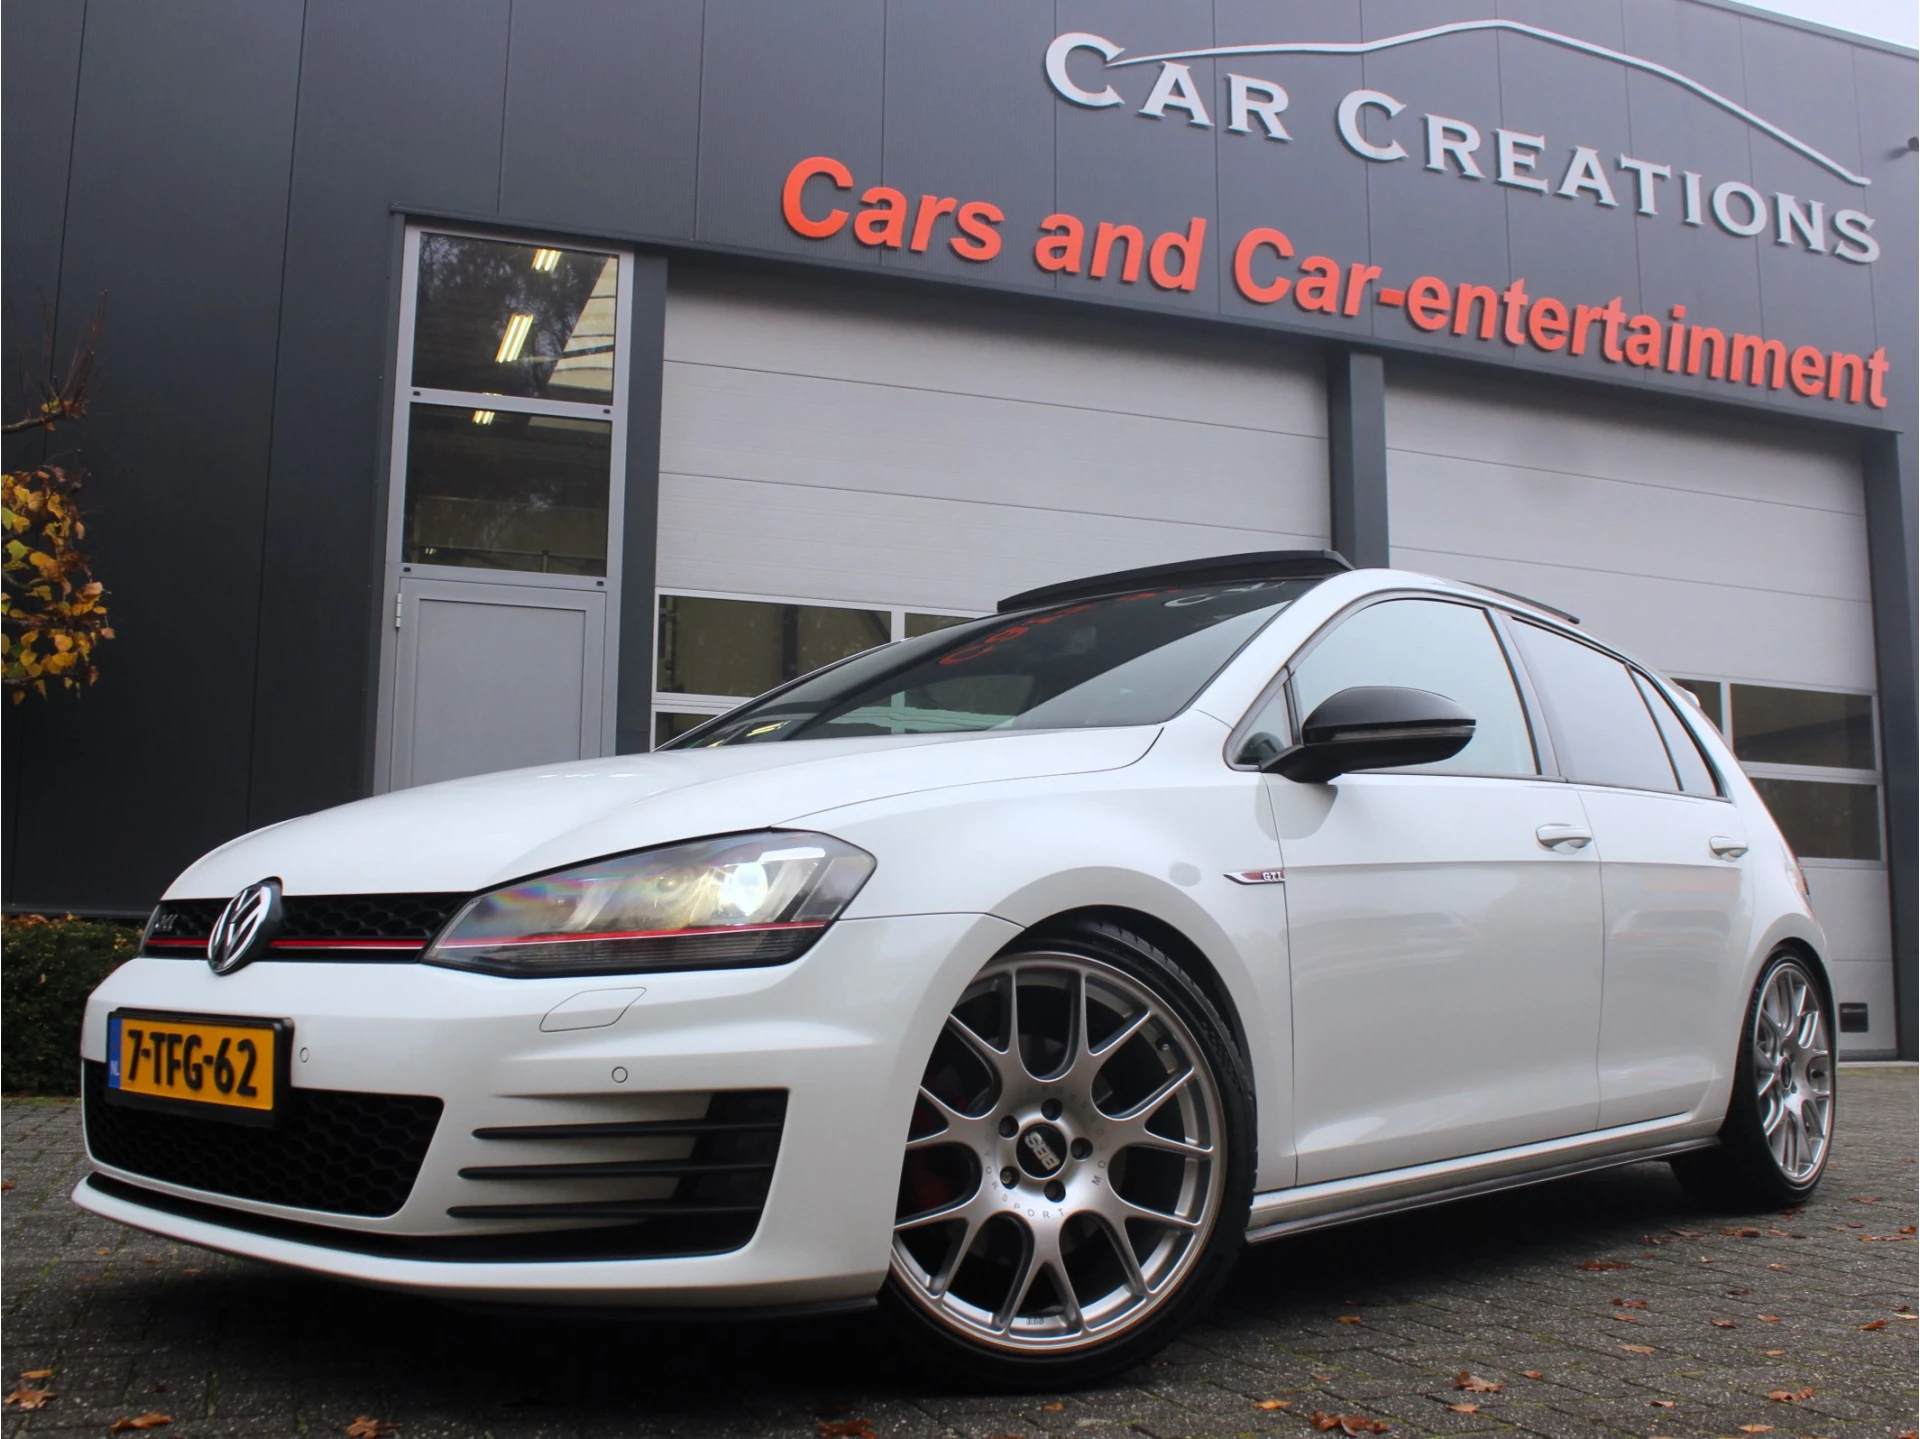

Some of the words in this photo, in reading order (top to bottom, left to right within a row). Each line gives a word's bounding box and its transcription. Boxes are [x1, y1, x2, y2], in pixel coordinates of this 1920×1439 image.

[1045, 31, 1293, 142] CAR
[1337, 89, 1881, 265] CREATIONS
[782, 156, 1005, 261] Cars
[1034, 213, 1207, 292] and
[1233, 226, 1889, 408] Car-entertainment
[1262, 871, 1282, 881] GTI
[110, 1060, 120, 1076] NL
[127, 1028, 257, 1098] 7-TFG-62
[1024, 1131, 1060, 1170] BBS
